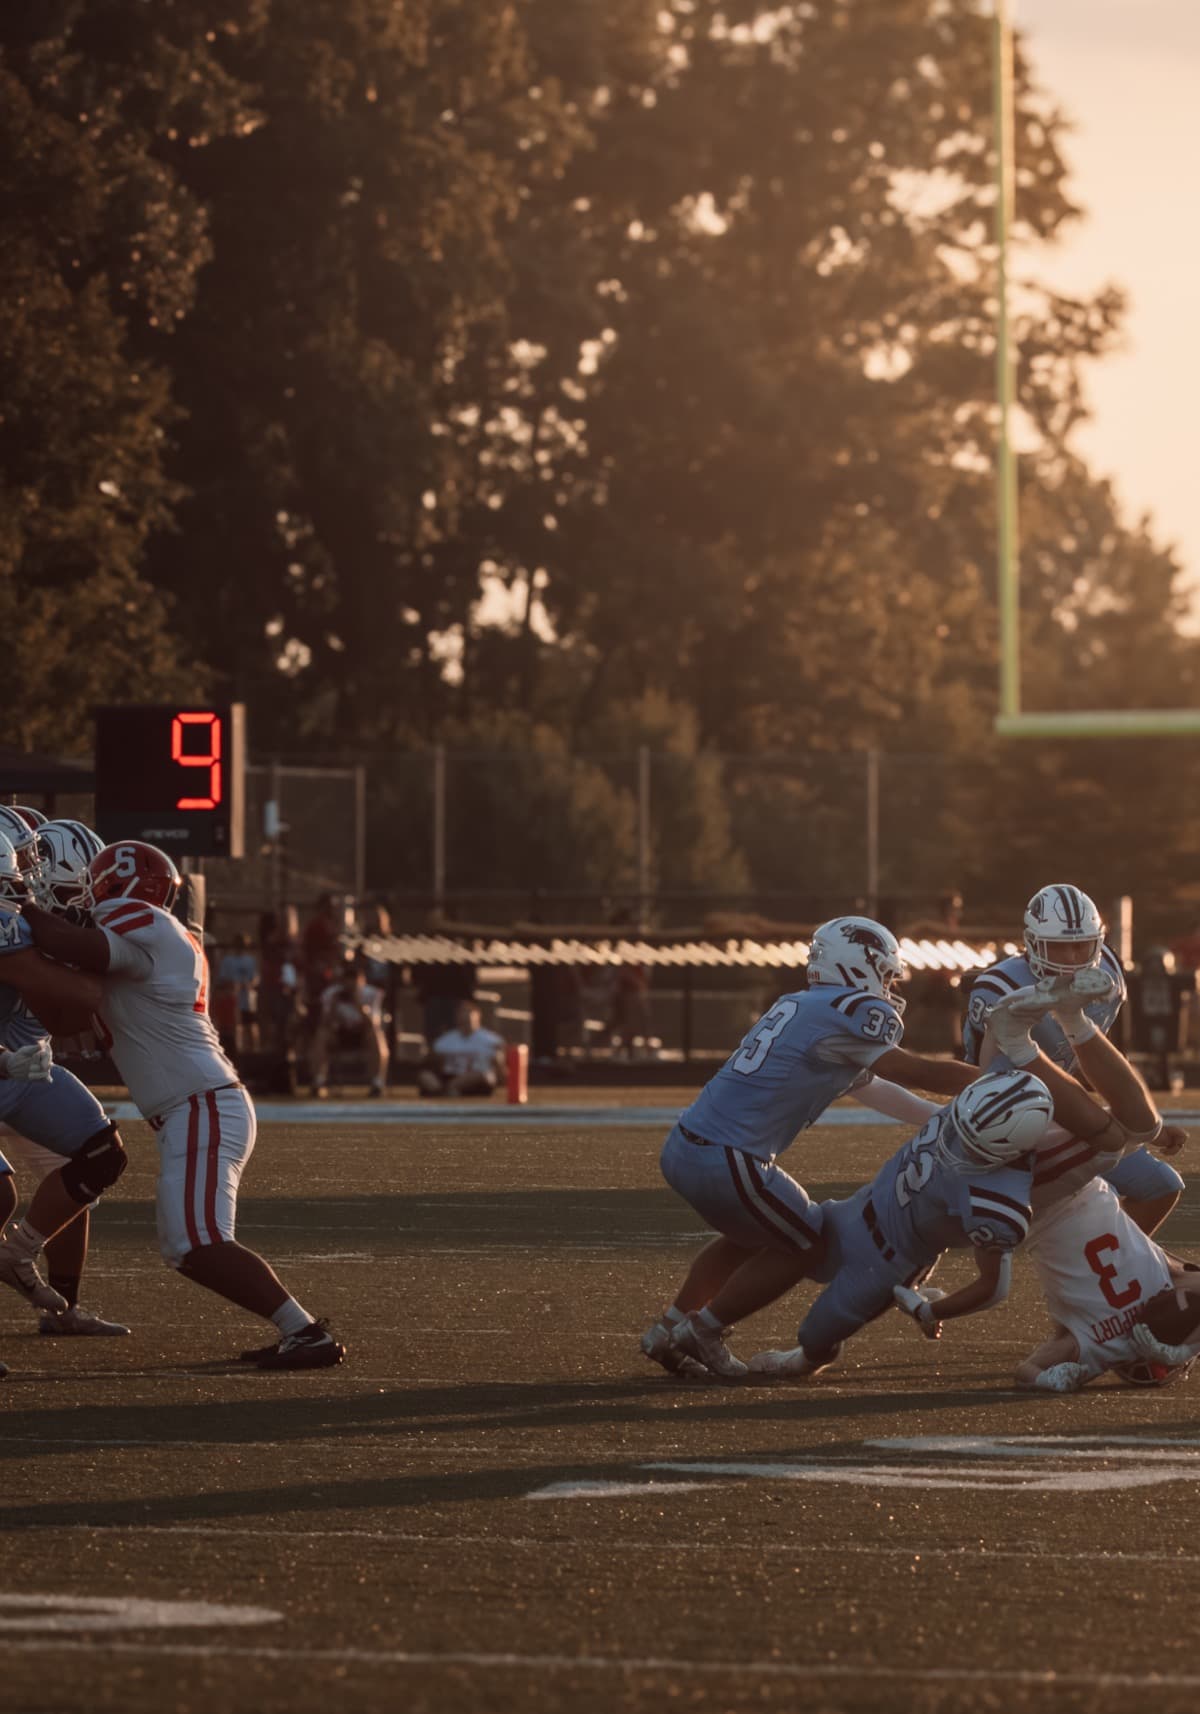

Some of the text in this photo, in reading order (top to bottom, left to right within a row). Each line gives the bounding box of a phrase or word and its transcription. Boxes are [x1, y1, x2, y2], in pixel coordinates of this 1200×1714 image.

[171, 712, 222, 810] 9
[115, 846, 136, 878] S
[862, 1007, 902, 1046] 33
[1084, 1232, 1142, 1310] 3
